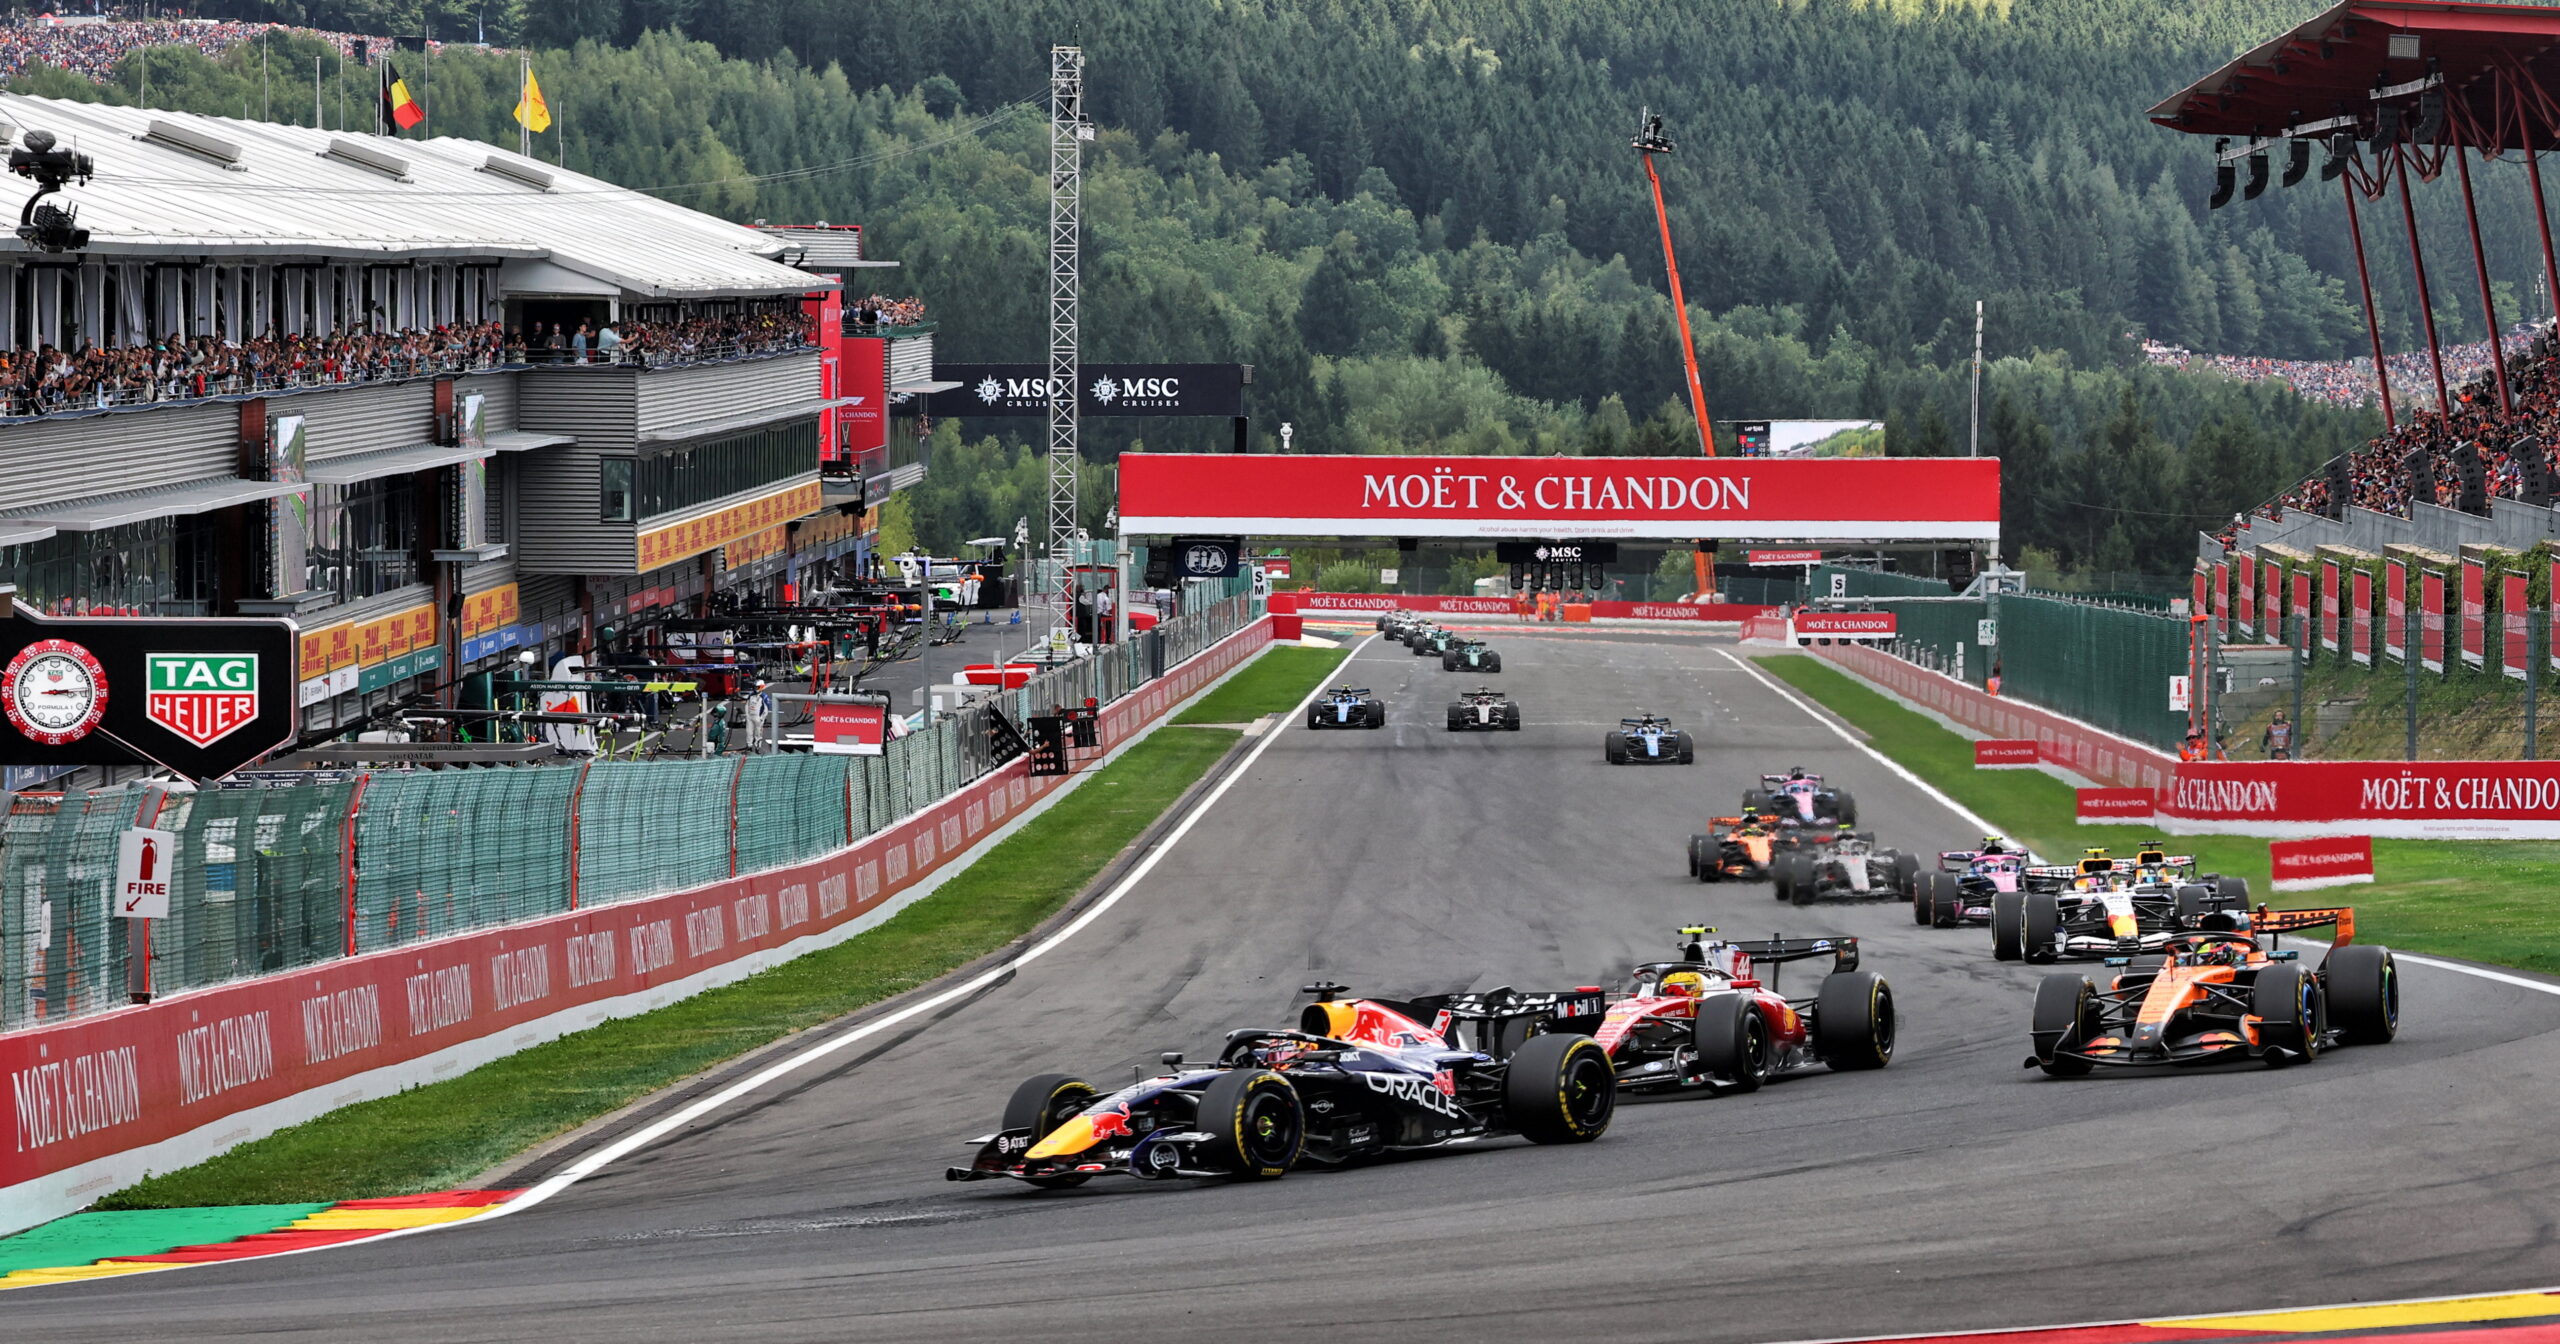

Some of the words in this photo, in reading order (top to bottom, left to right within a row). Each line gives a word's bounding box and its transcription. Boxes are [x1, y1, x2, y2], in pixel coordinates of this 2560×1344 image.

[1122, 378, 1179, 398] MSC
[1361, 467, 1488, 509] MOËT
[1497, 474, 1526, 510] &
[1534, 474, 1751, 511] CHANDON
[1551, 547, 1581, 557] MSC
[1310, 596, 1338, 608] MOËT
[1339, 598, 1347, 608] &
[1347, 598, 1398, 609] CHANDON
[1807, 619, 1832, 629] MOËT
[1833, 620, 1840, 629] &
[1841, 620, 1888, 629] CHANDON
[155, 661, 248, 687] TAG
[153, 697, 251, 740] HEUER
[820, 715, 840, 724] MOËT
[2188, 778, 2278, 812] CHANDON
[2360, 770, 2431, 810] MOËT
[2434, 777, 2450, 810] &
[2455, 777, 2560, 810] CHANDO
[127, 881, 166, 896] FIRE
[302, 980, 332, 1066] MOËT
[330, 993, 341, 1060] &
[337, 983, 382, 1056] CHANDON
[1557, 1001, 1588, 1019] Mobil
[176, 1009, 211, 1107] MOËT
[210, 1022, 222, 1096] &
[219, 1010, 274, 1091] CHANDON
[11, 1043, 63, 1153] MOËT
[63, 1058, 78, 1140] &
[75, 1045, 141, 1135] CHANDON
[1365, 1072, 1459, 1119] ORACLE
[1010, 1137, 1029, 1149] AT&T
